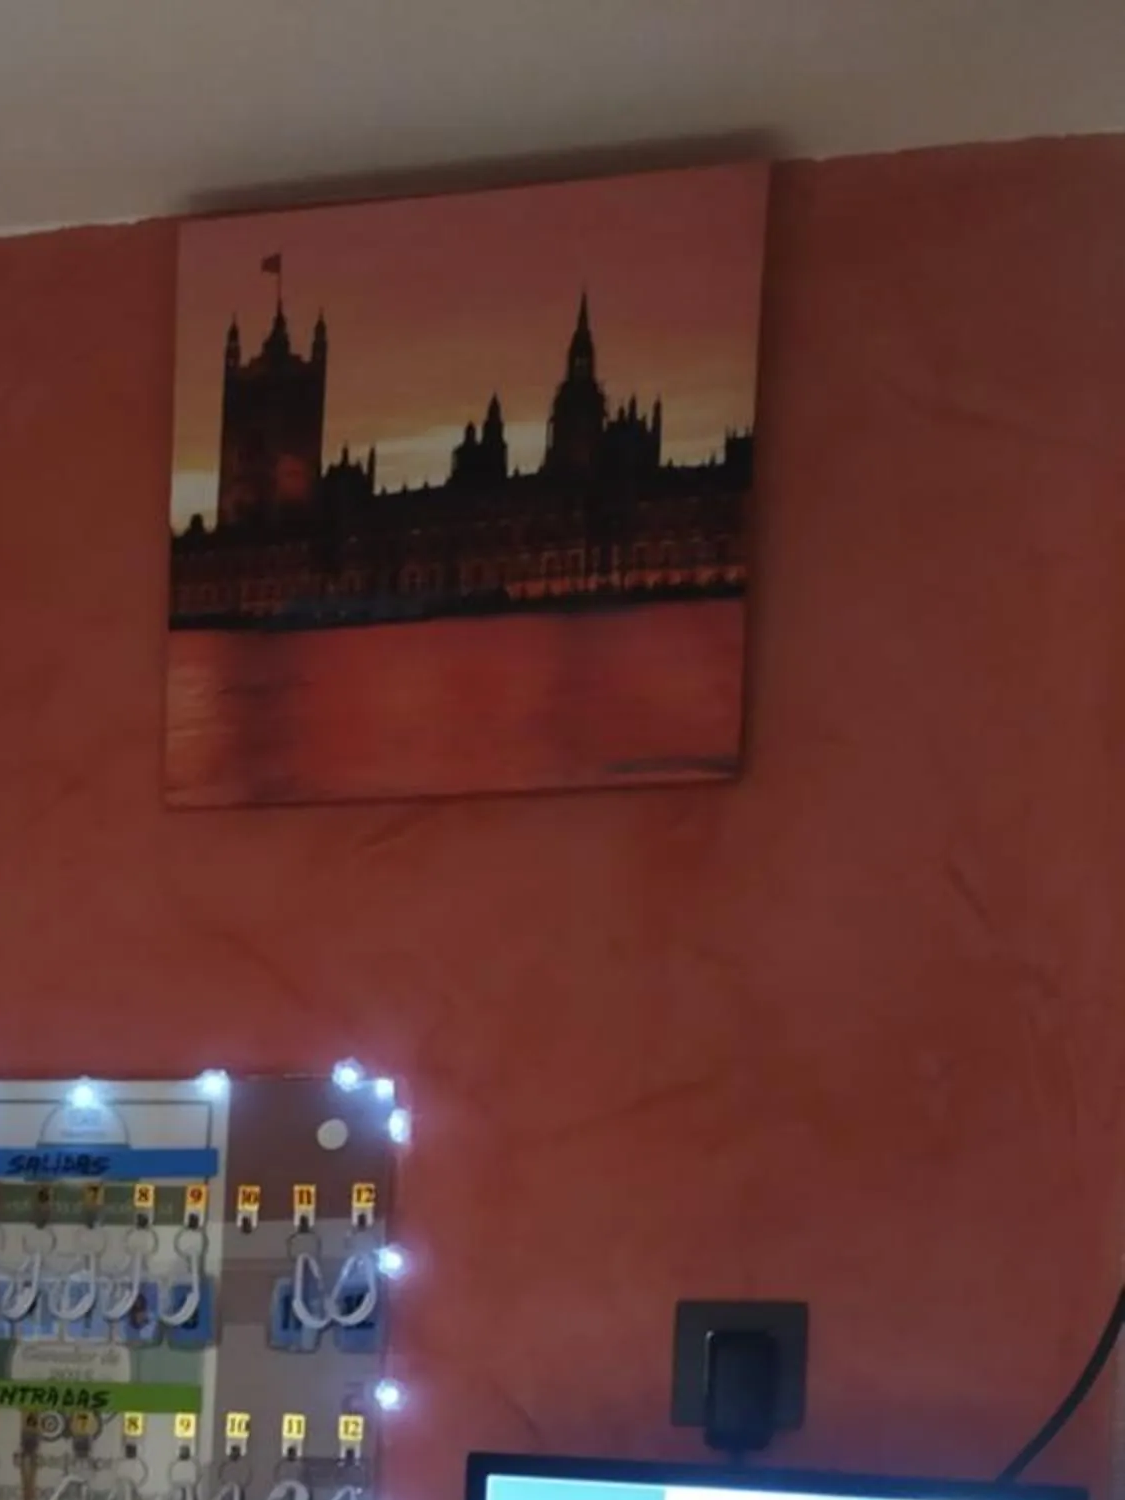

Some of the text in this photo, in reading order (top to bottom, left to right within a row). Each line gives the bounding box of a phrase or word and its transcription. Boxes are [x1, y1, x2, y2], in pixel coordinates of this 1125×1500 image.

[6, 1153, 111, 1176] SALIDAS
[138, 1186, 150, 1200] 8
[189, 1190, 203, 1204] 9
[241, 1190, 259, 1205] 10
[297, 1189, 313, 1205] 11
[354, 1187, 375, 1203] 12
[127, 1416, 139, 1431] 8
[179, 1418, 191, 1433] 9
[287, 1419, 303, 1435] 11
[342, 1420, 359, 1436] 12
